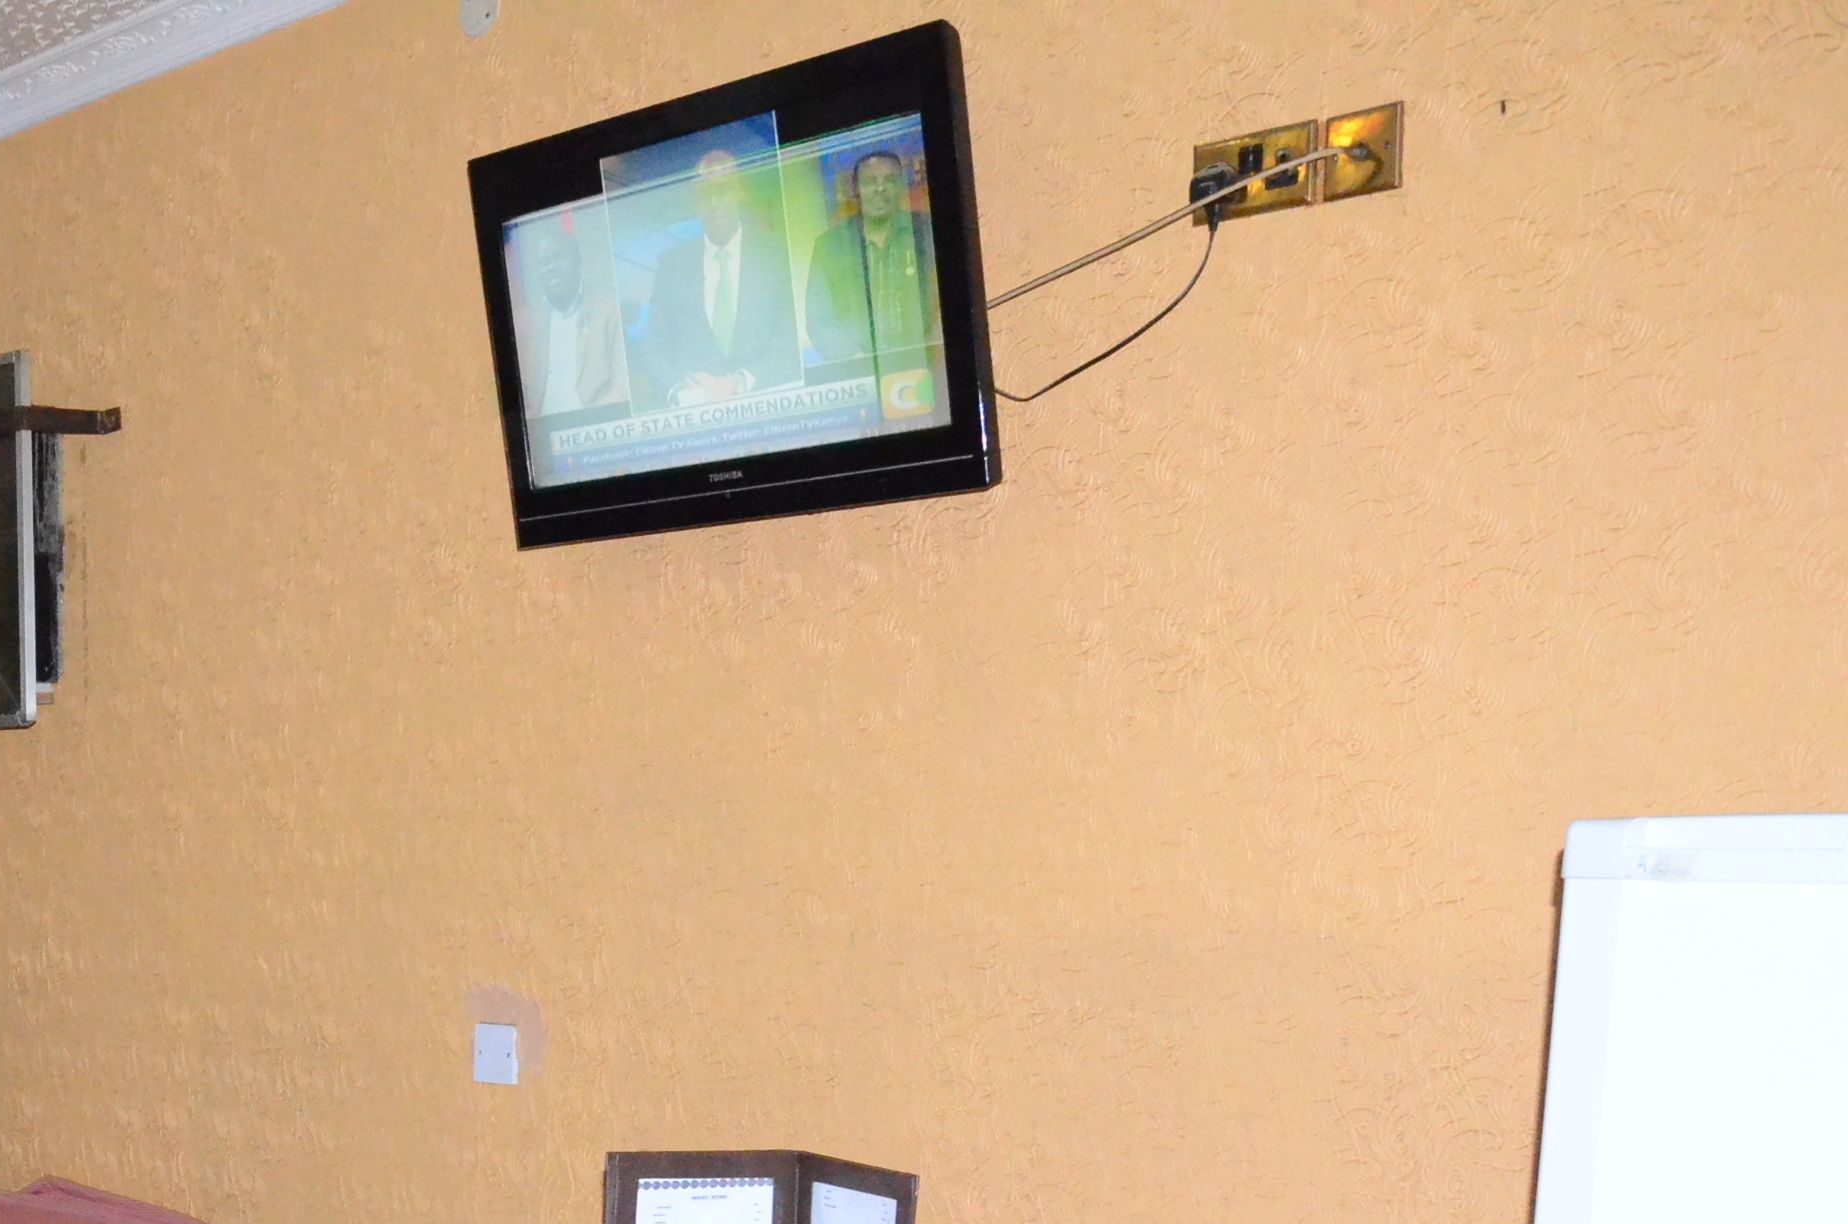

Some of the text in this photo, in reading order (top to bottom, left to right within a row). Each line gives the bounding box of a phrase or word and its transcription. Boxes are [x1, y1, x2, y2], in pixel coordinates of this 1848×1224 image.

[559, 383, 868, 449] HEAD OF STATE COMMENDATIONS
[708, 469, 744, 484] TOSHIBA
